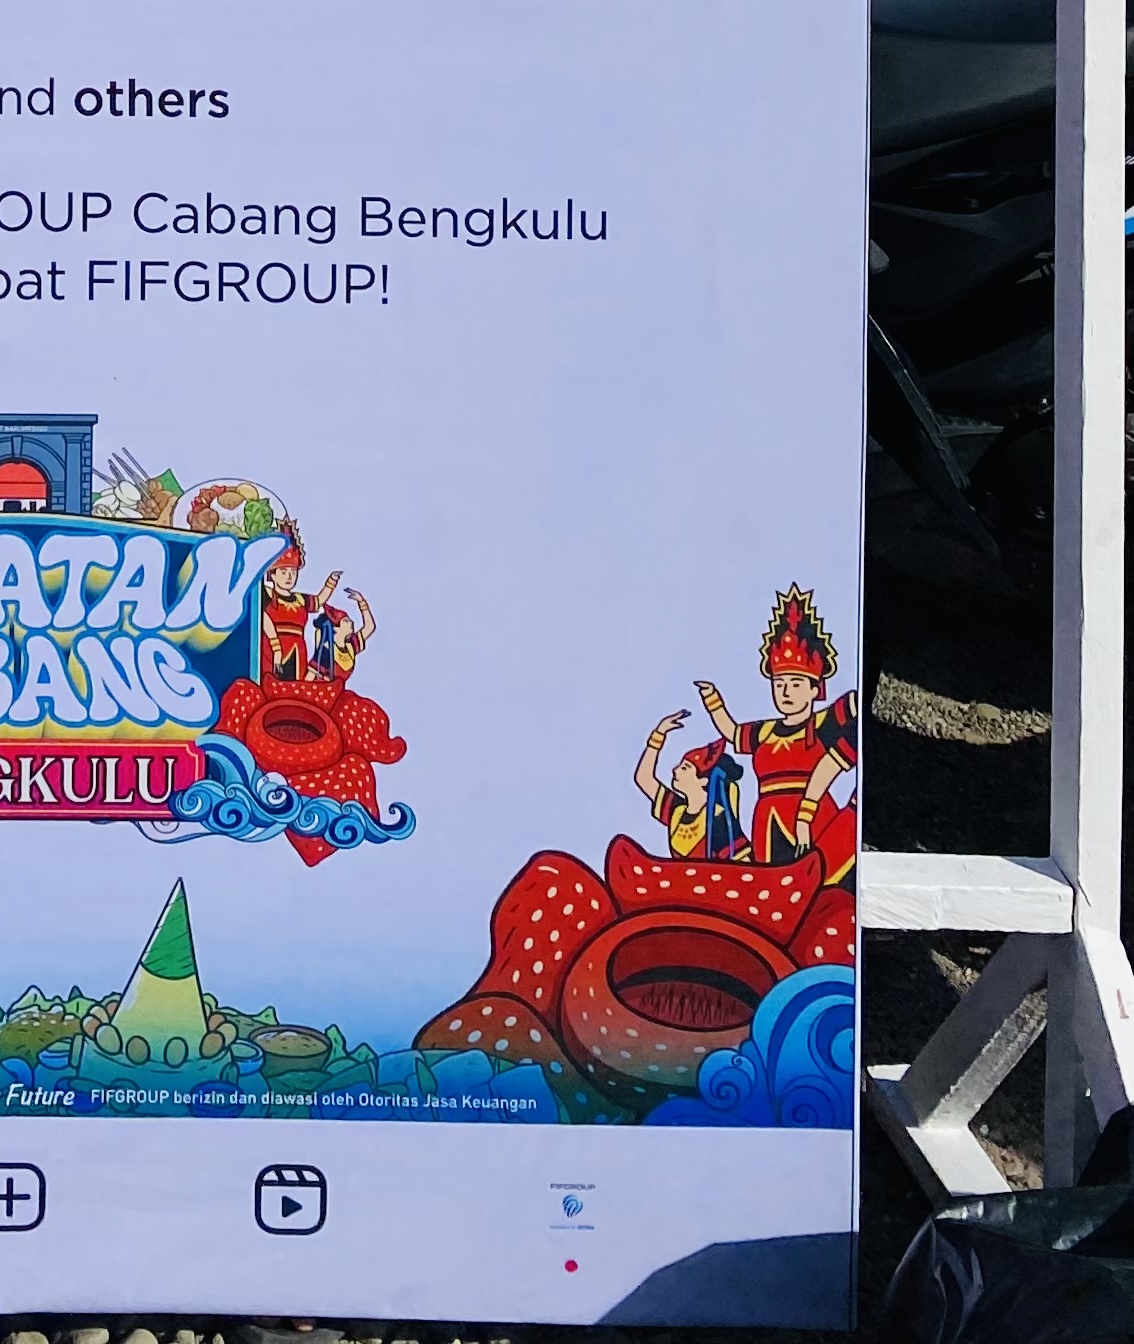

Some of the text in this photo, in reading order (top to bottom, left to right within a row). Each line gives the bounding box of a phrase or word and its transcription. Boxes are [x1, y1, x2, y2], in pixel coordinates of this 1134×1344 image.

[74, 78, 230, 119] others
[133, 191, 337, 245] Cabang
[360, 196, 608, 248] Bengkulu
[86, 260, 390, 306] FIFGROUP!
[5, 1083, 76, 1108] Future
[90, 1089, 538, 1114] FIFGROUP berizin dan diawasi oleh Otoritas Jasa Keuangan
